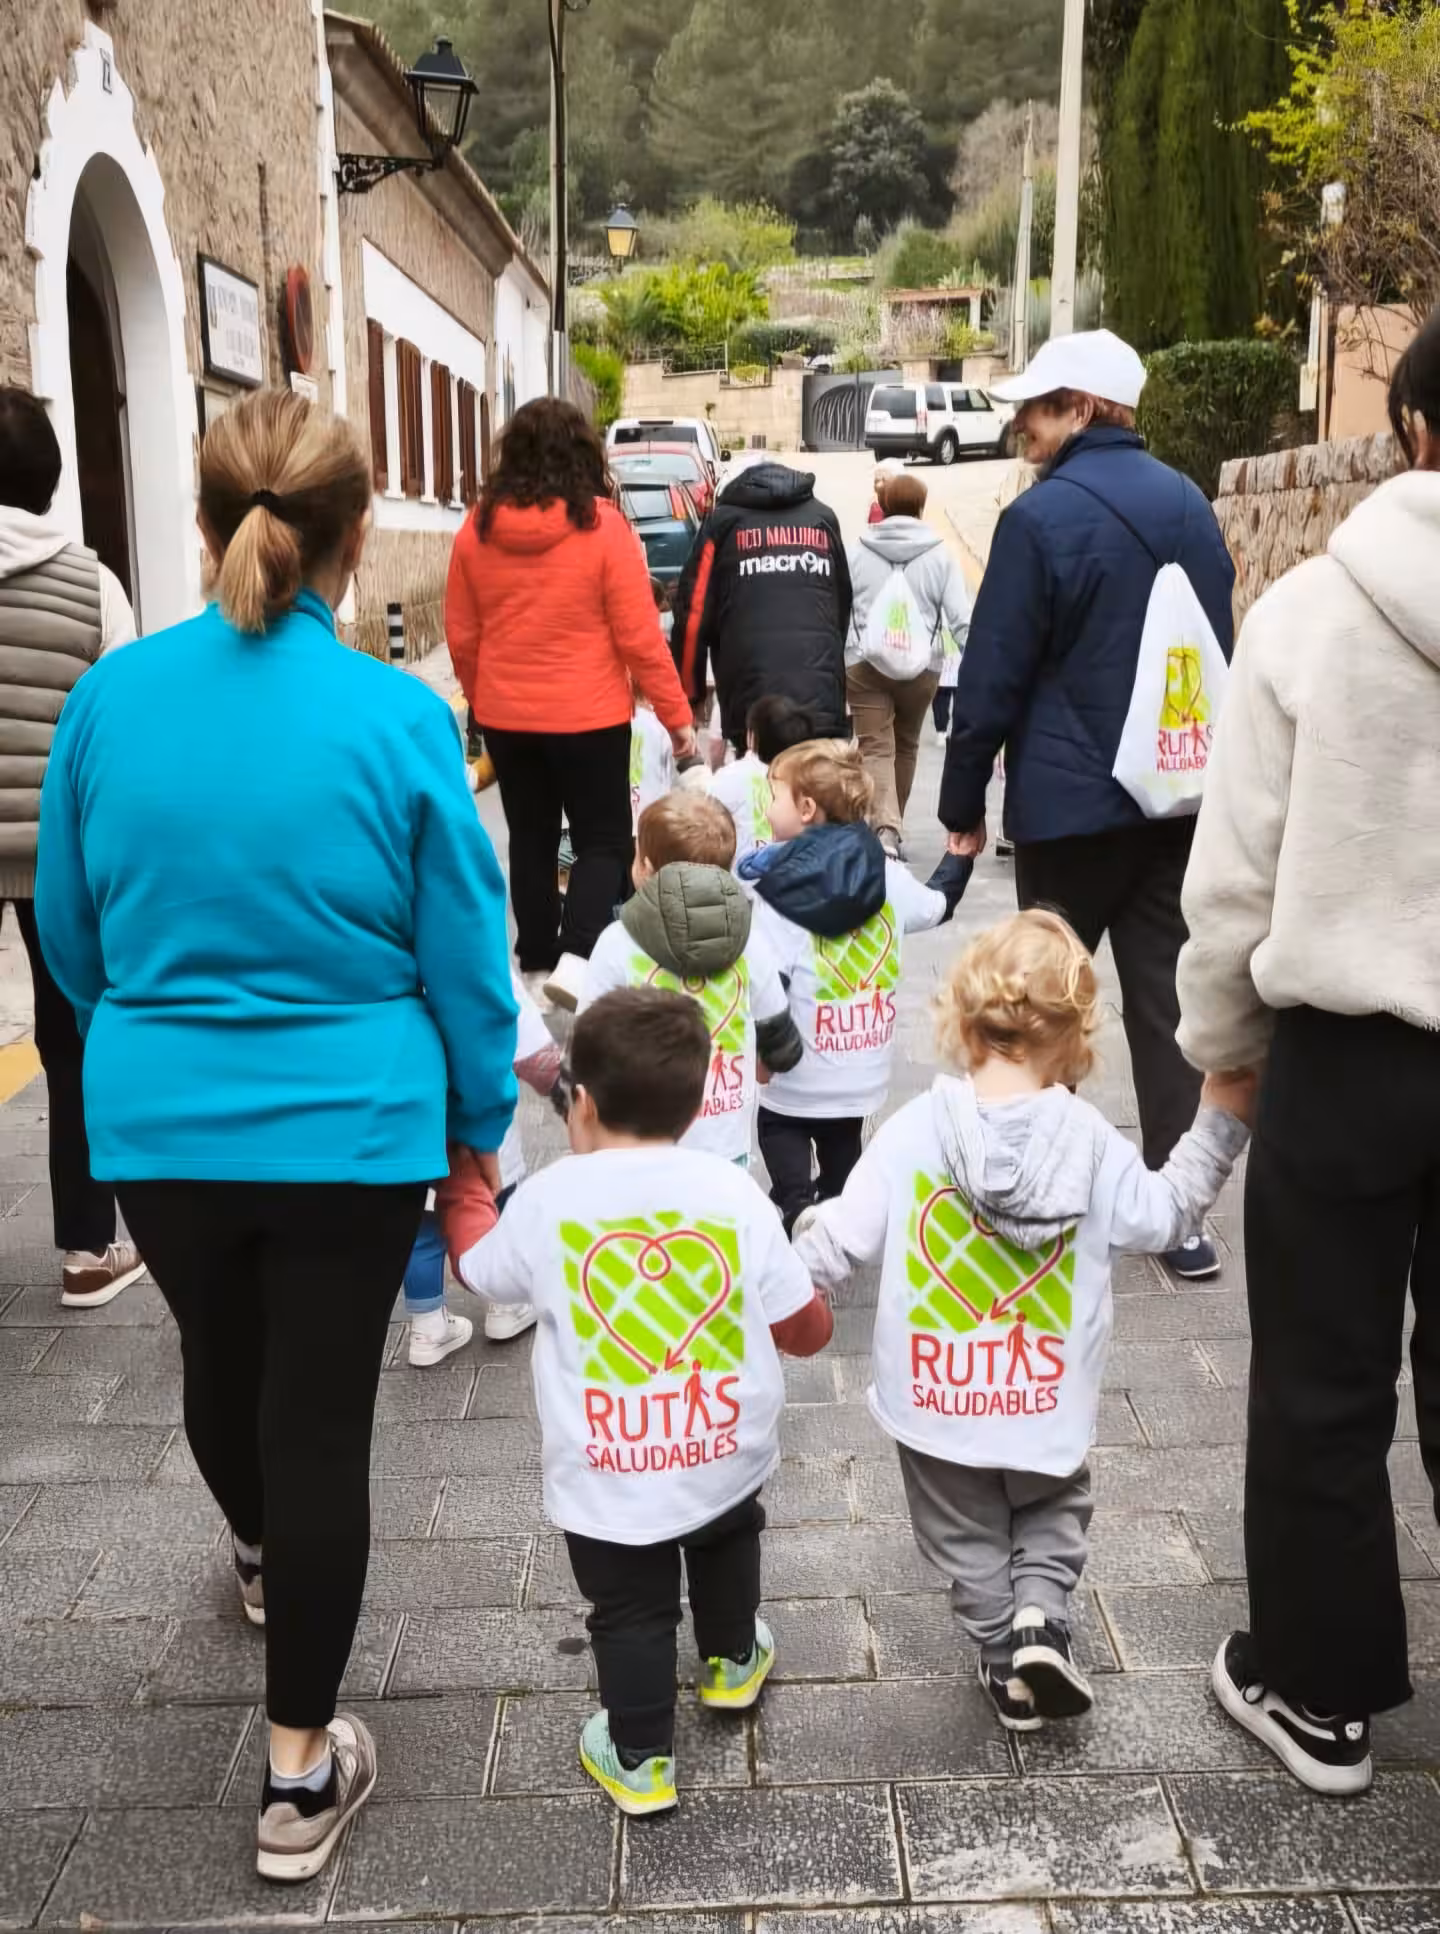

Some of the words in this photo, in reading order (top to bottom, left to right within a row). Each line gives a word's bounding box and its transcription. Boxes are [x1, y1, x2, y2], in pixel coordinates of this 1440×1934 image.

[739, 551, 831, 577] macron
[816, 985, 897, 1035] RUTAS
[911, 1312, 1065, 1387] RUTAS
[584, 1359, 741, 1443] RUTAS
[912, 1384, 1060, 1416] SALUDABLES
[585, 1429, 738, 1473] SALUDABLES
